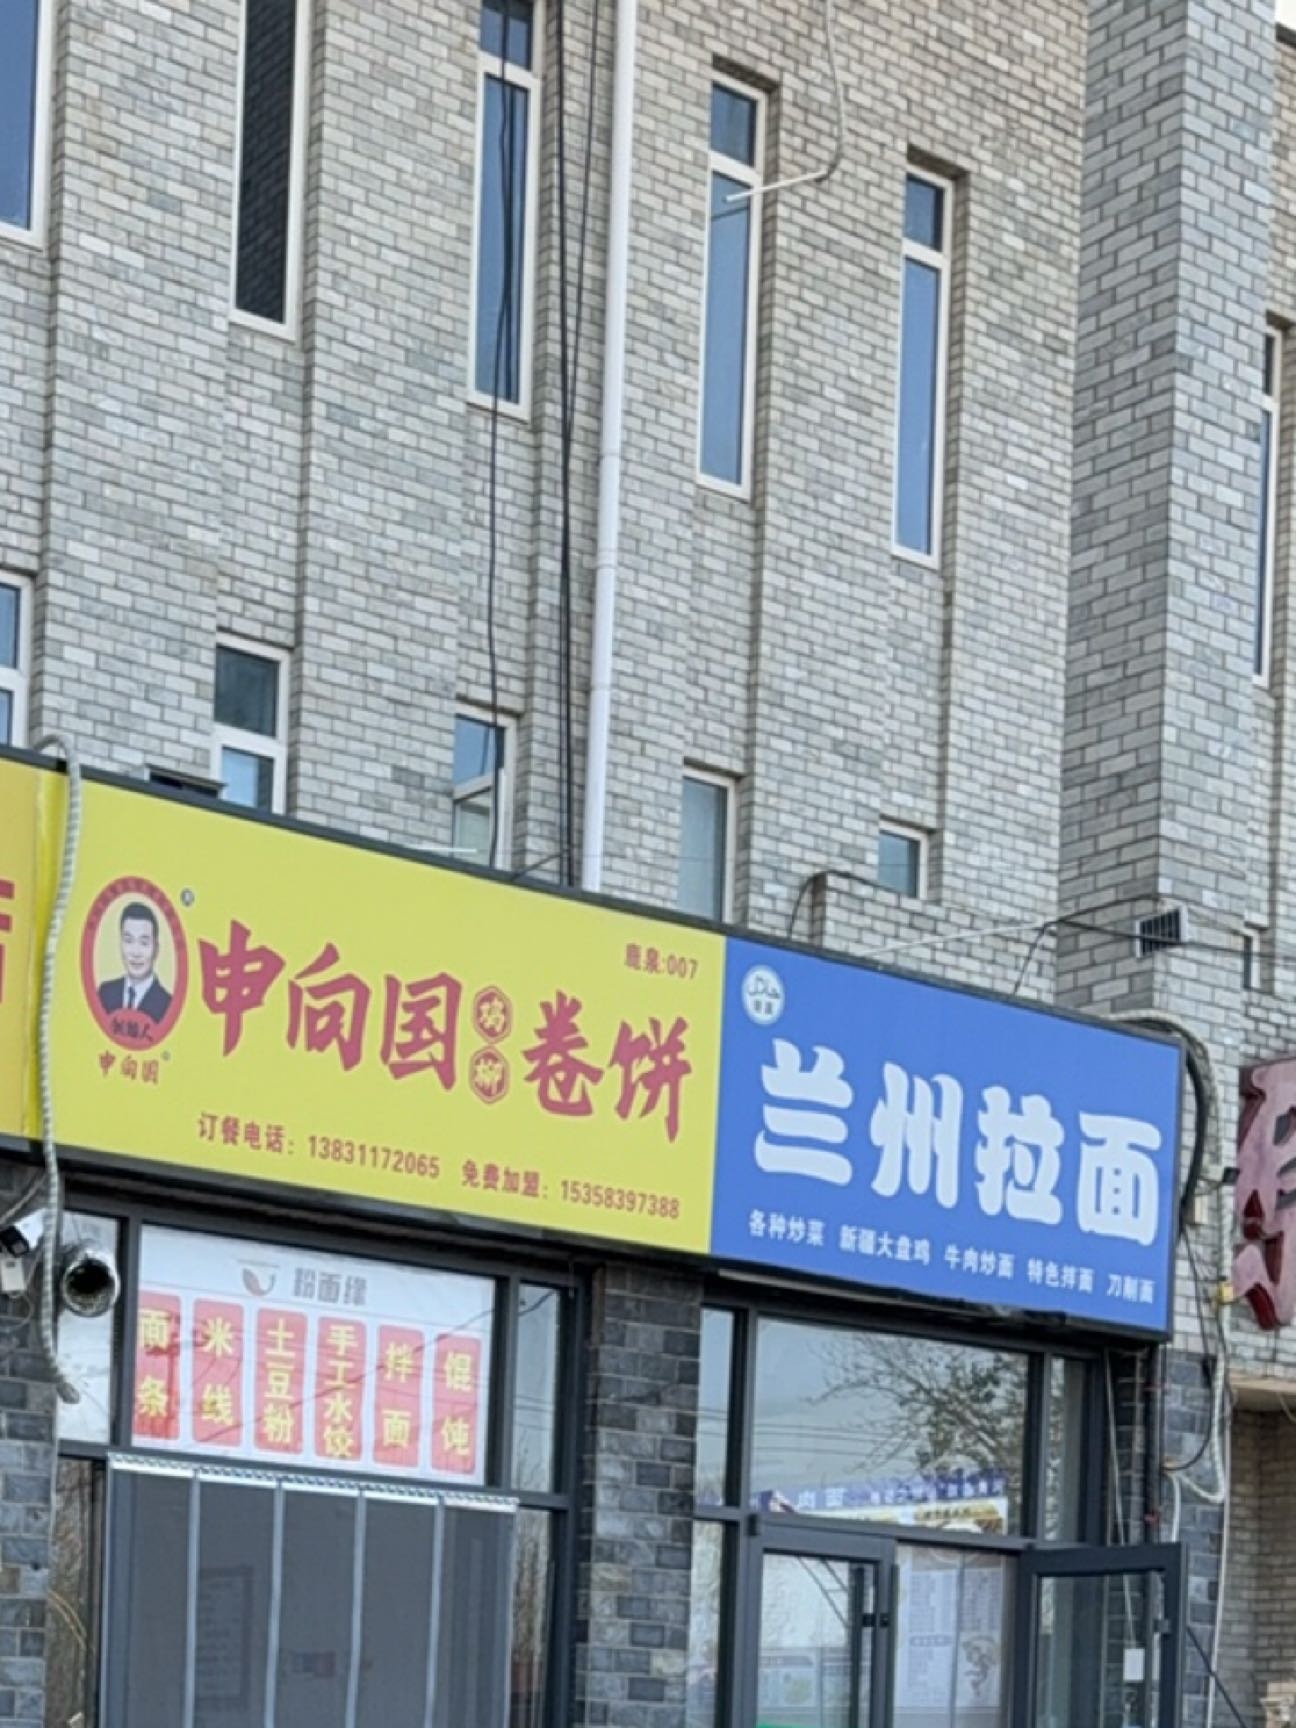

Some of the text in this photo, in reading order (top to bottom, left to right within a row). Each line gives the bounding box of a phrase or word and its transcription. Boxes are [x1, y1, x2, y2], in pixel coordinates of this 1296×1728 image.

[197, 919, 463, 1091] 申向国
[522, 989, 693, 1143] 卷饼
[307, 1134, 441, 1179] 13831172065
[754, 1038, 1163, 1246] 兰州拉面
[748, 1208, 1155, 1304] 各种炒菜 新疆大盘鸡 牛肉炒面 特色拌面 刀削面
[136, 1308, 172, 1418] 面条
[201, 1316, 234, 1426] 米线
[263, 1317, 296, 1443] 土豆粉
[322, 1324, 359, 1457] 手工水饺
[382, 1341, 414, 1448] 拌面
[440, 1351, 473, 1456] 馄饨
